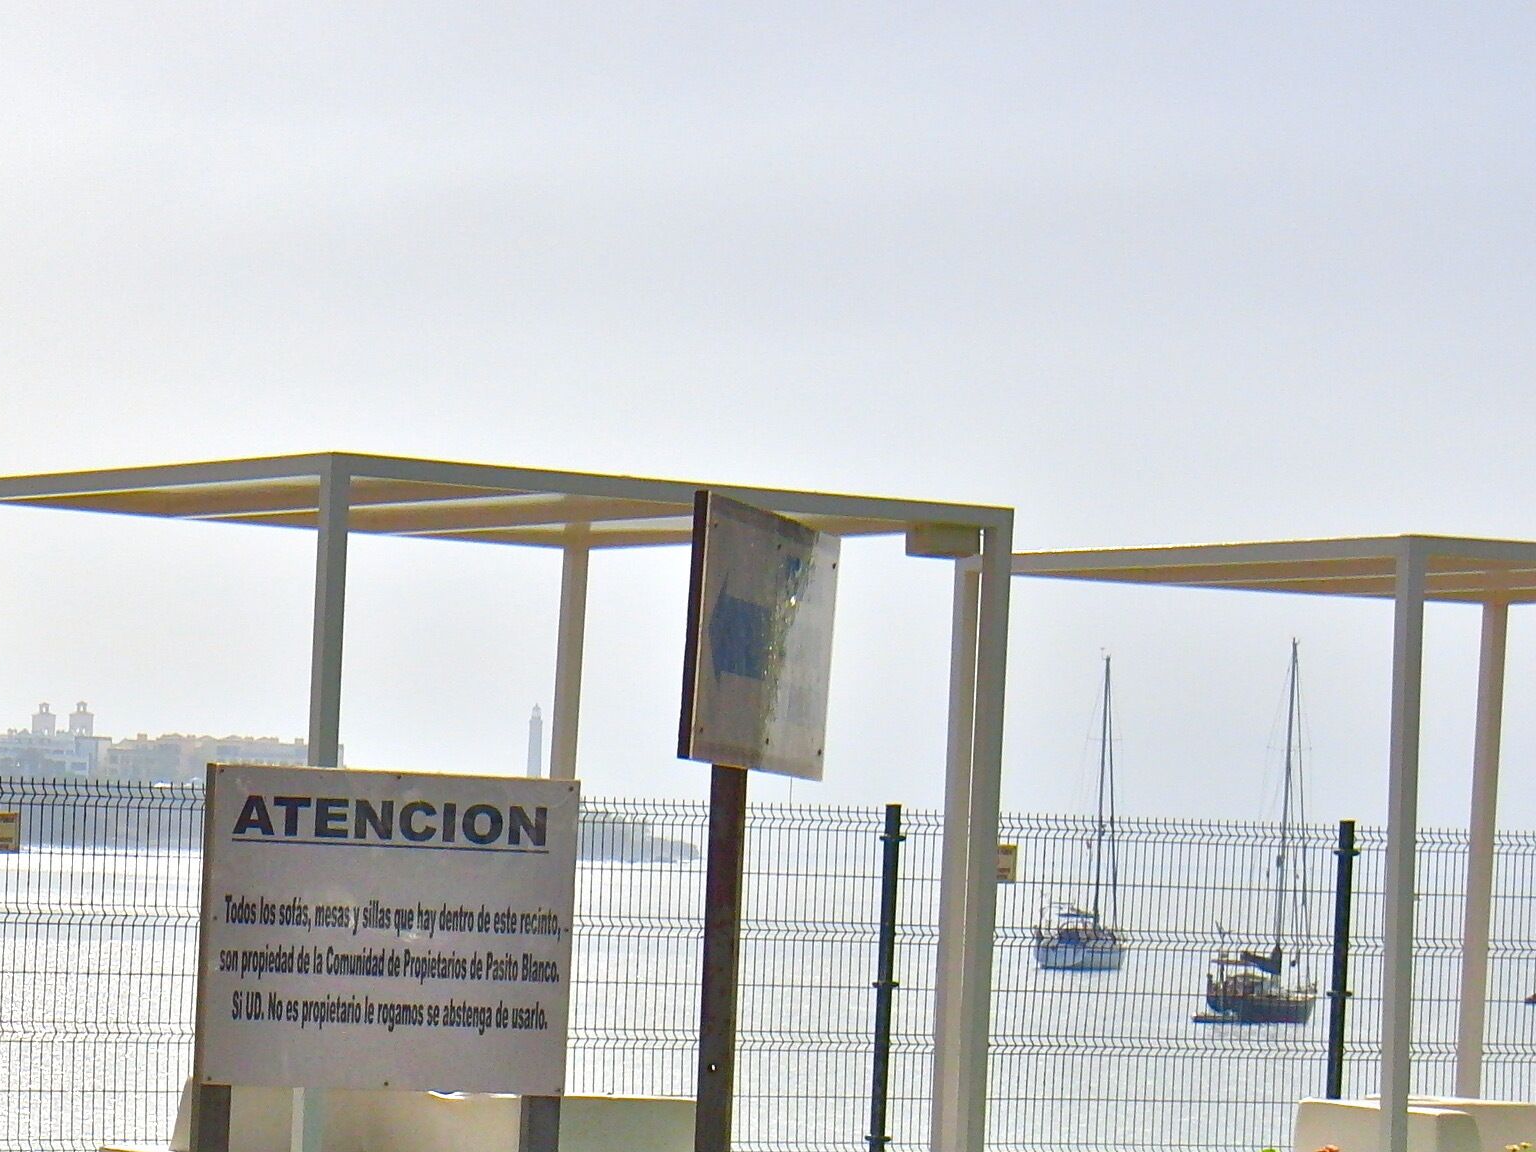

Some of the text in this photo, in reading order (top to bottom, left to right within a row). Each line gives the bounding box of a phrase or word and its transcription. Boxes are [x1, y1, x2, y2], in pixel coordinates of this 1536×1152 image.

[232, 795, 548, 847] ATENCION
[225, 894, 561, 943] Todos los sofás, mesas y sillas que hay dentro de este recinto,
[219, 944, 560, 985] son propiedad de la Comunidad de Propietarios de Pasito Blanco.
[232, 990, 548, 1035] Si UD. No es propietario le rogamos se abstenga de usarlo.
